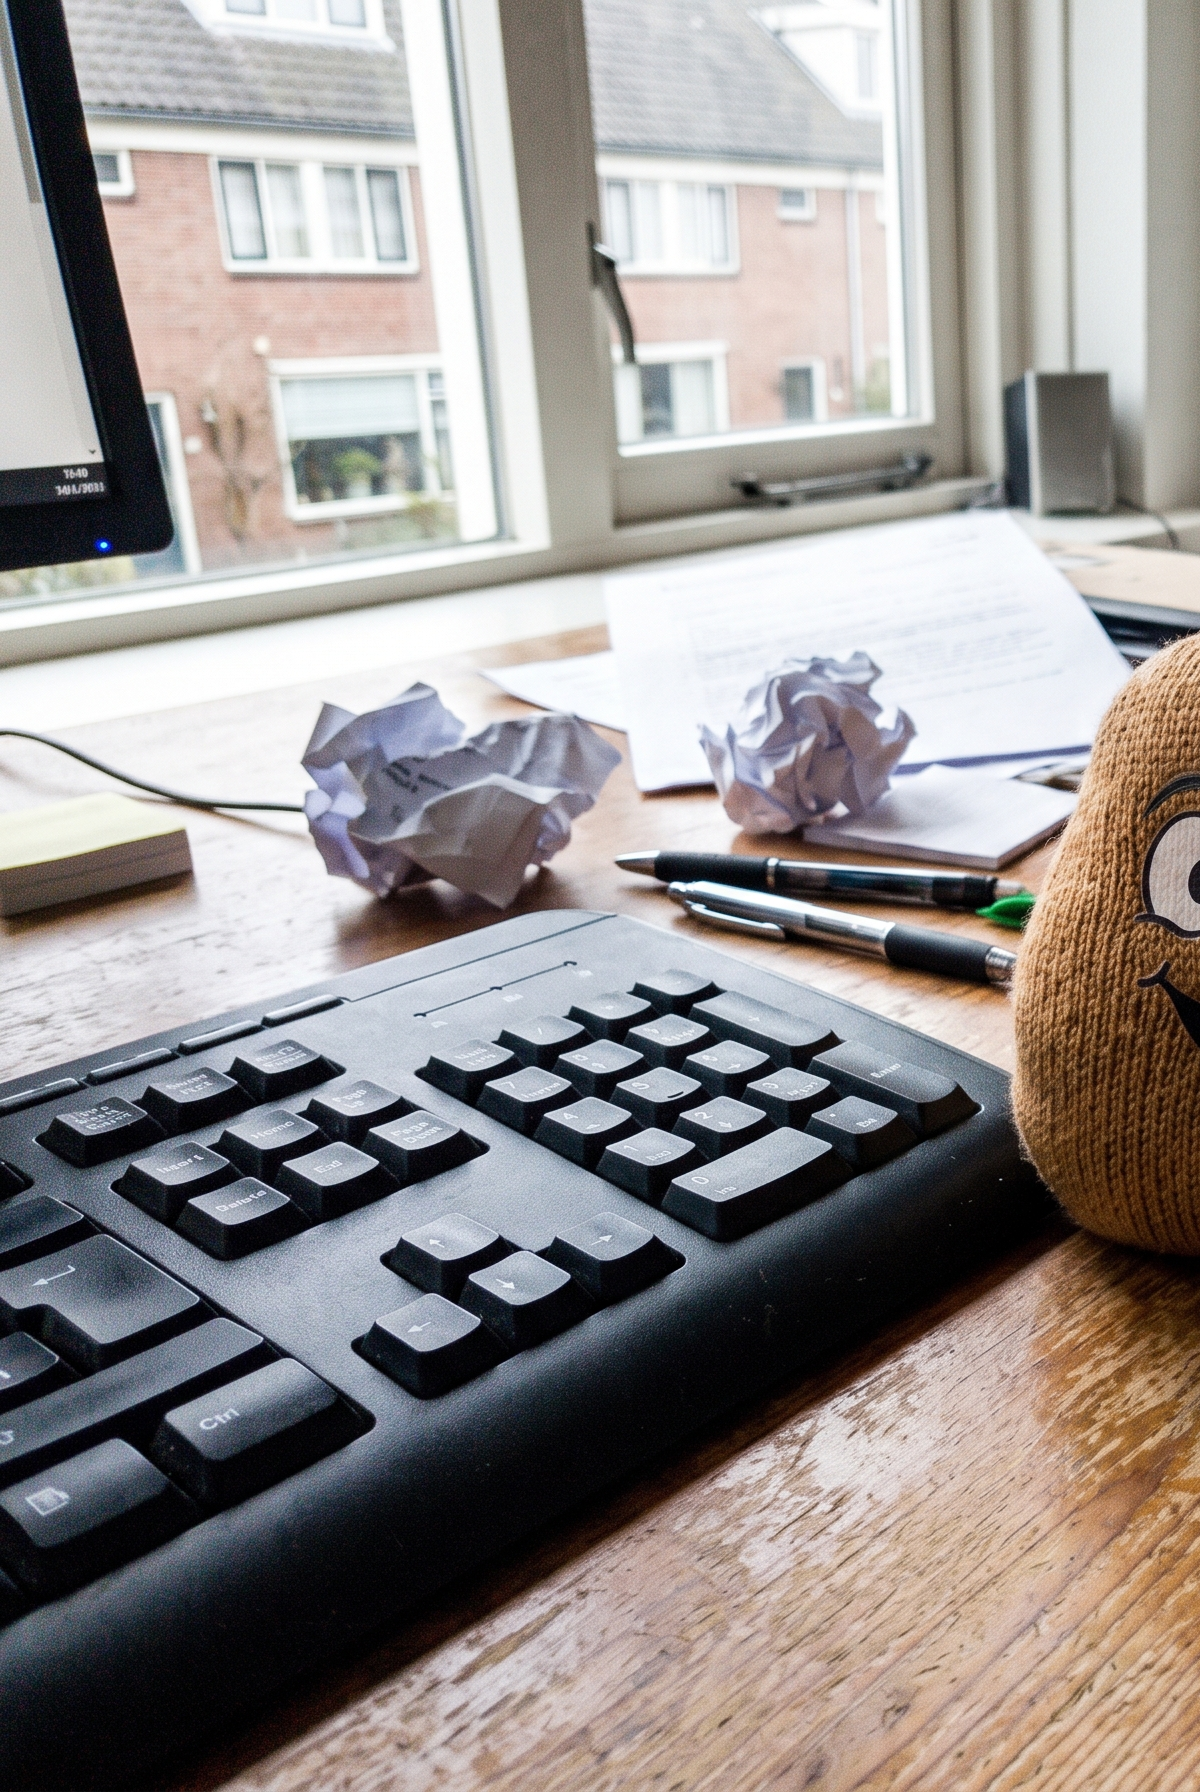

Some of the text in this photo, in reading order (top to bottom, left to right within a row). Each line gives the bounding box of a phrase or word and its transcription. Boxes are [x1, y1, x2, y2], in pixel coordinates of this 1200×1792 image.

[694, 1111, 714, 1120] 2
[691, 1176, 710, 1185] 0
[199, 1408, 240, 1430] Ctrl
